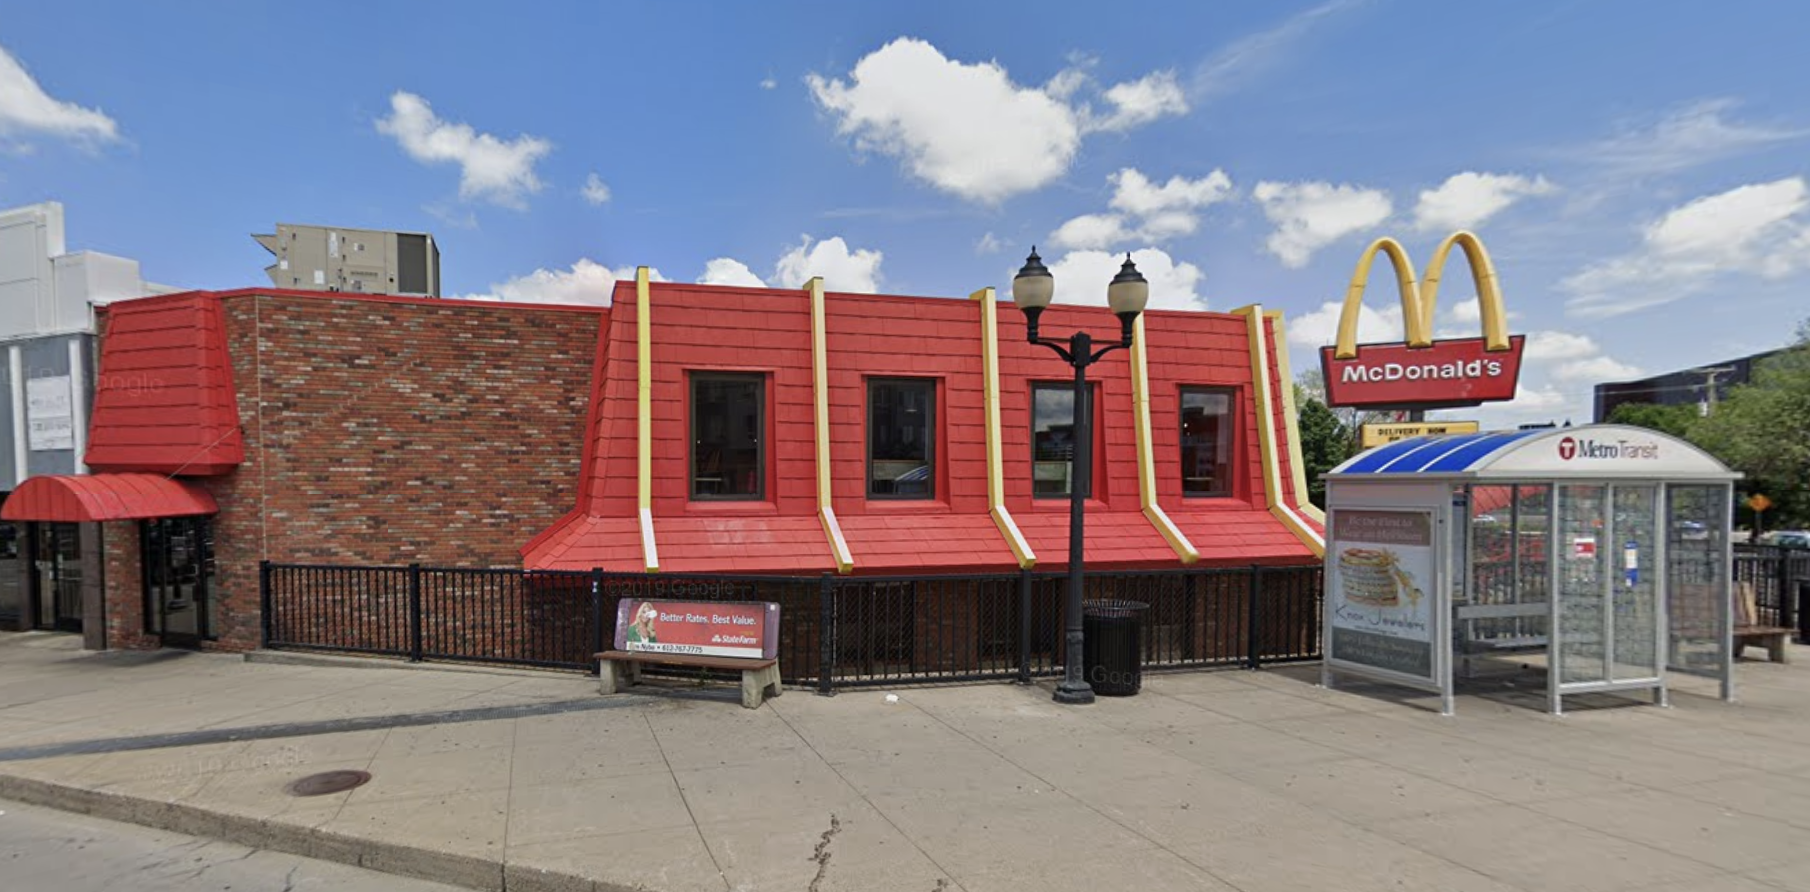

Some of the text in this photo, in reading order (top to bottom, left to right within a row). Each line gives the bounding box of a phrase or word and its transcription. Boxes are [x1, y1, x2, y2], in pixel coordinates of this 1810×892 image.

[1341, 358, 1502, 383] McDonald's
[1377, 426, 1447, 437] DELIVERY NOW
[1578, 439, 1659, 460] Metro Transit
[660, 612, 757, 626] Better Rates. Best Value.
[662, 644, 704, 654] 612-767-7775
